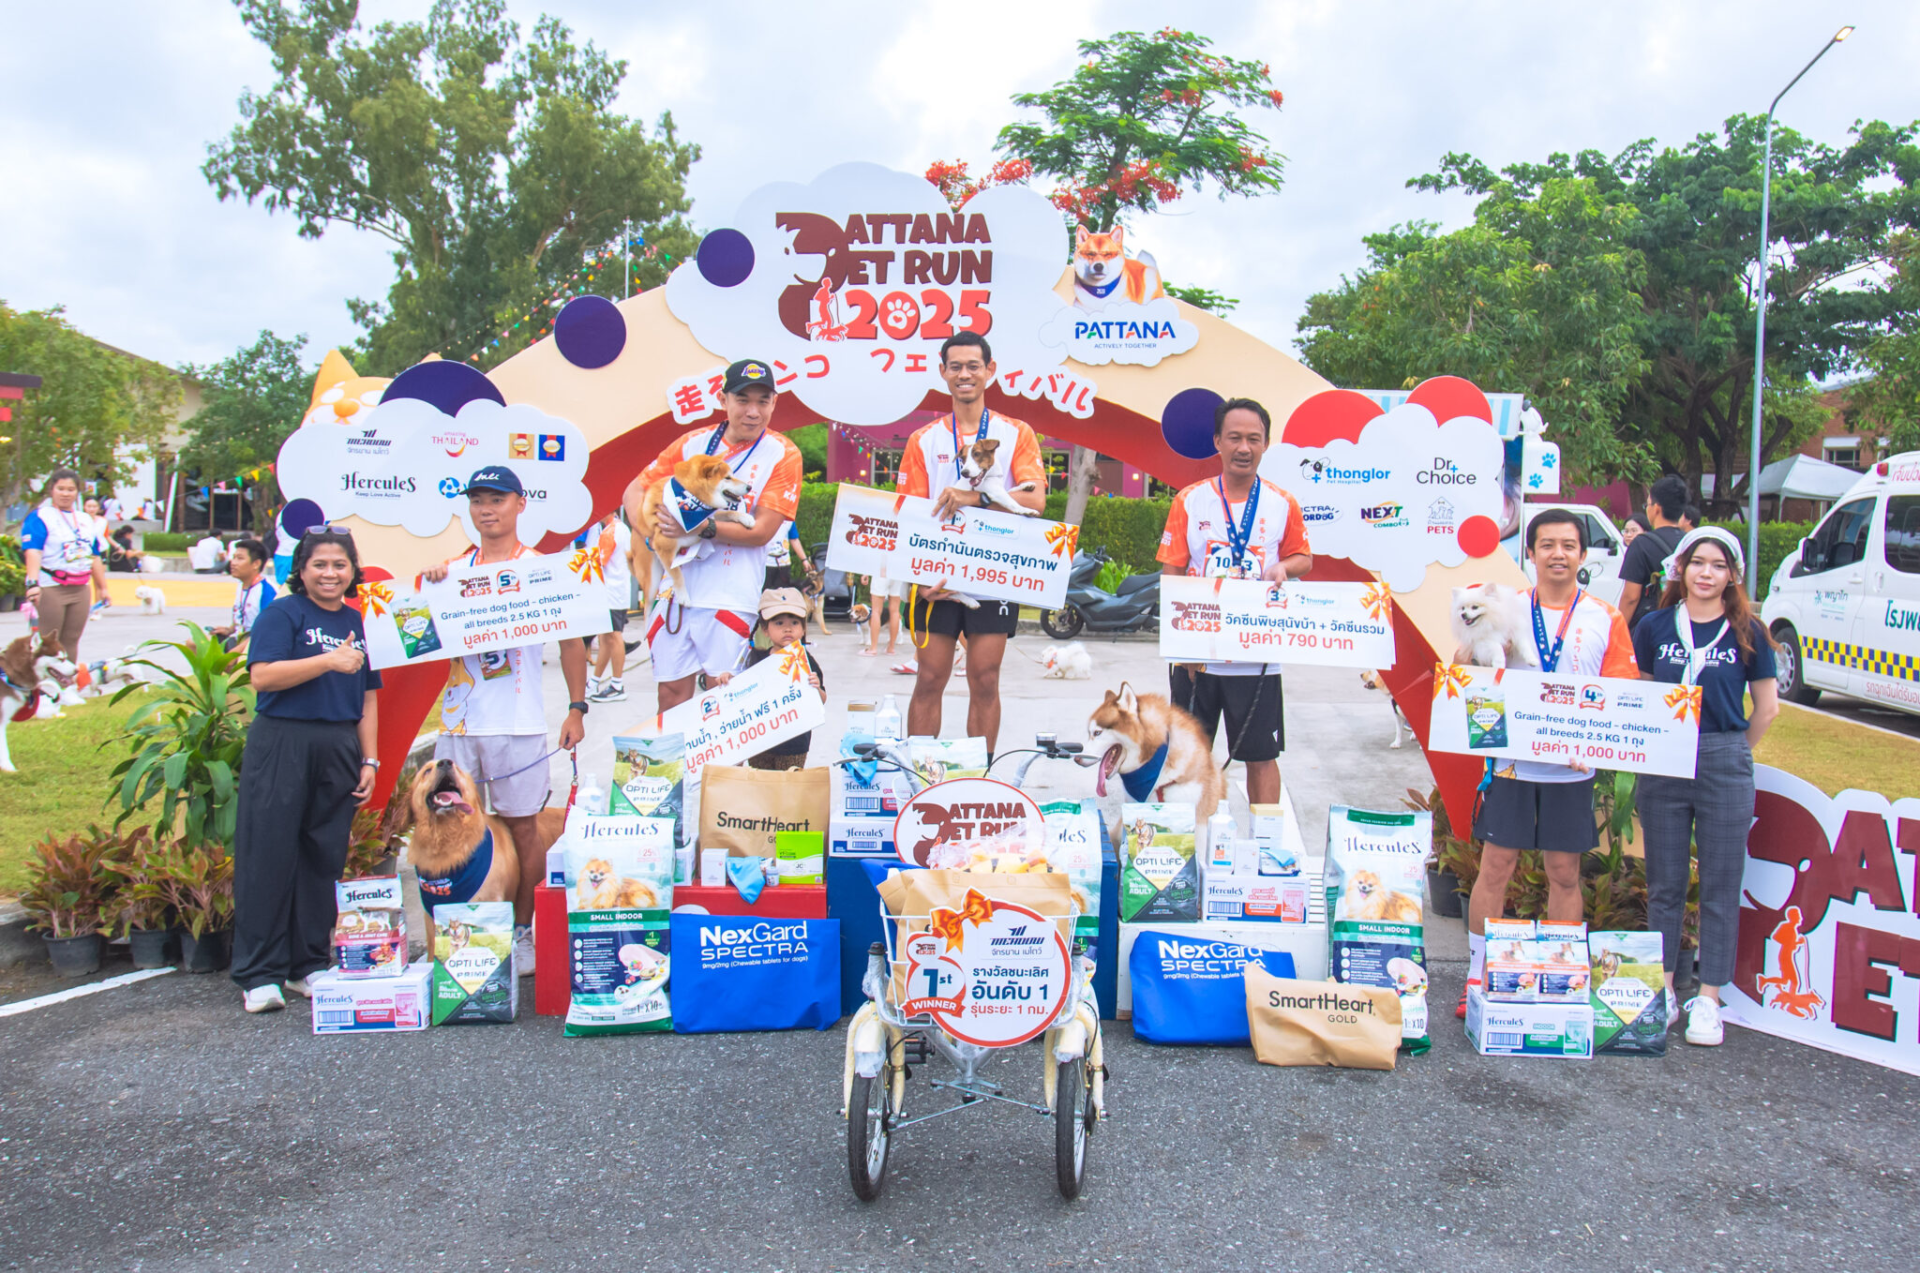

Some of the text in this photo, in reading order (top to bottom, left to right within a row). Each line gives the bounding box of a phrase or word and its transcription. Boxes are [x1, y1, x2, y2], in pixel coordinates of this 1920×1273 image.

[904, 250, 993, 285] RUN
[844, 288, 993, 341] 2025
[1075, 321, 1176, 339] PATTANA
[432, 436, 480, 446] THAILAND
[1326, 467, 1391, 483] thonglor
[1416, 470, 1477, 485] Choice
[1361, 506, 1403, 520] NEXT
[876, 527, 899, 539] RUN
[985, 524, 1014, 535] thonglor
[1427, 526, 1454, 534] PETS
[860, 534, 896, 551] 2025
[1215, 556, 1253, 571] 103
[911, 557, 1045, 592] มูลค่า 1,995 บาท
[441, 593, 574, 621] Grain-free dog food chicken
[464, 606, 562, 630] all breeds 2.5 KG 1 ถุง
[1200, 611, 1221, 620] RUN
[463, 619, 568, 649] มูลค่า 1,000 บาท
[1187, 619, 1222, 633] 2025
[1239, 629, 1353, 651] มูลค่า 790 บาท
[754, 701, 770, 718] ฟรี
[773, 700, 778, 709] 1
[782, 685, 802, 705] ครั้ง
[1514, 711, 1661, 734] Grain-free dog food chicken
[686, 708, 799, 775] มูลค่า 1,000 บาท
[1536, 727, 1548, 735] all
[1550, 728, 1584, 739] breeds
[1586, 731, 1602, 741] 2.5
[1605, 733, 1620, 743] KG
[1632, 736, 1644, 748] ถุง
[1532, 740, 1646, 763] มูลค่า 1,000 บาท
[626, 784, 649, 793] OPTI
[716, 811, 810, 832] SmartHeart
[1136, 857, 1182, 866] OPTI LIFE
[590, 912, 643, 921] SMALL INDOOR
[700, 920, 808, 947] NexGard
[1358, 924, 1410, 934] SMALL INDOOR
[701, 942, 809, 961] SPECTRA
[449, 957, 496, 968] OPTI LIFE
[730, 959, 761, 967] (Chewable
[762, 957, 781, 965] tablets
[791, 955, 808, 963] dogs)
[972, 965, 1049, 978] รางวัลชนะเลิศ
[923, 968, 953, 998] 1st
[971, 980, 1048, 1000] อันดับ 1
[1600, 988, 1650, 998] OPTI LIFE
[911, 1000, 957, 1011] WINNER
[970, 1002, 1049, 1018] รุ่นระยะ 1 กม.
[1268, 990, 1374, 1015] SmartHeart
[1328, 1014, 1358, 1024] GOLD
